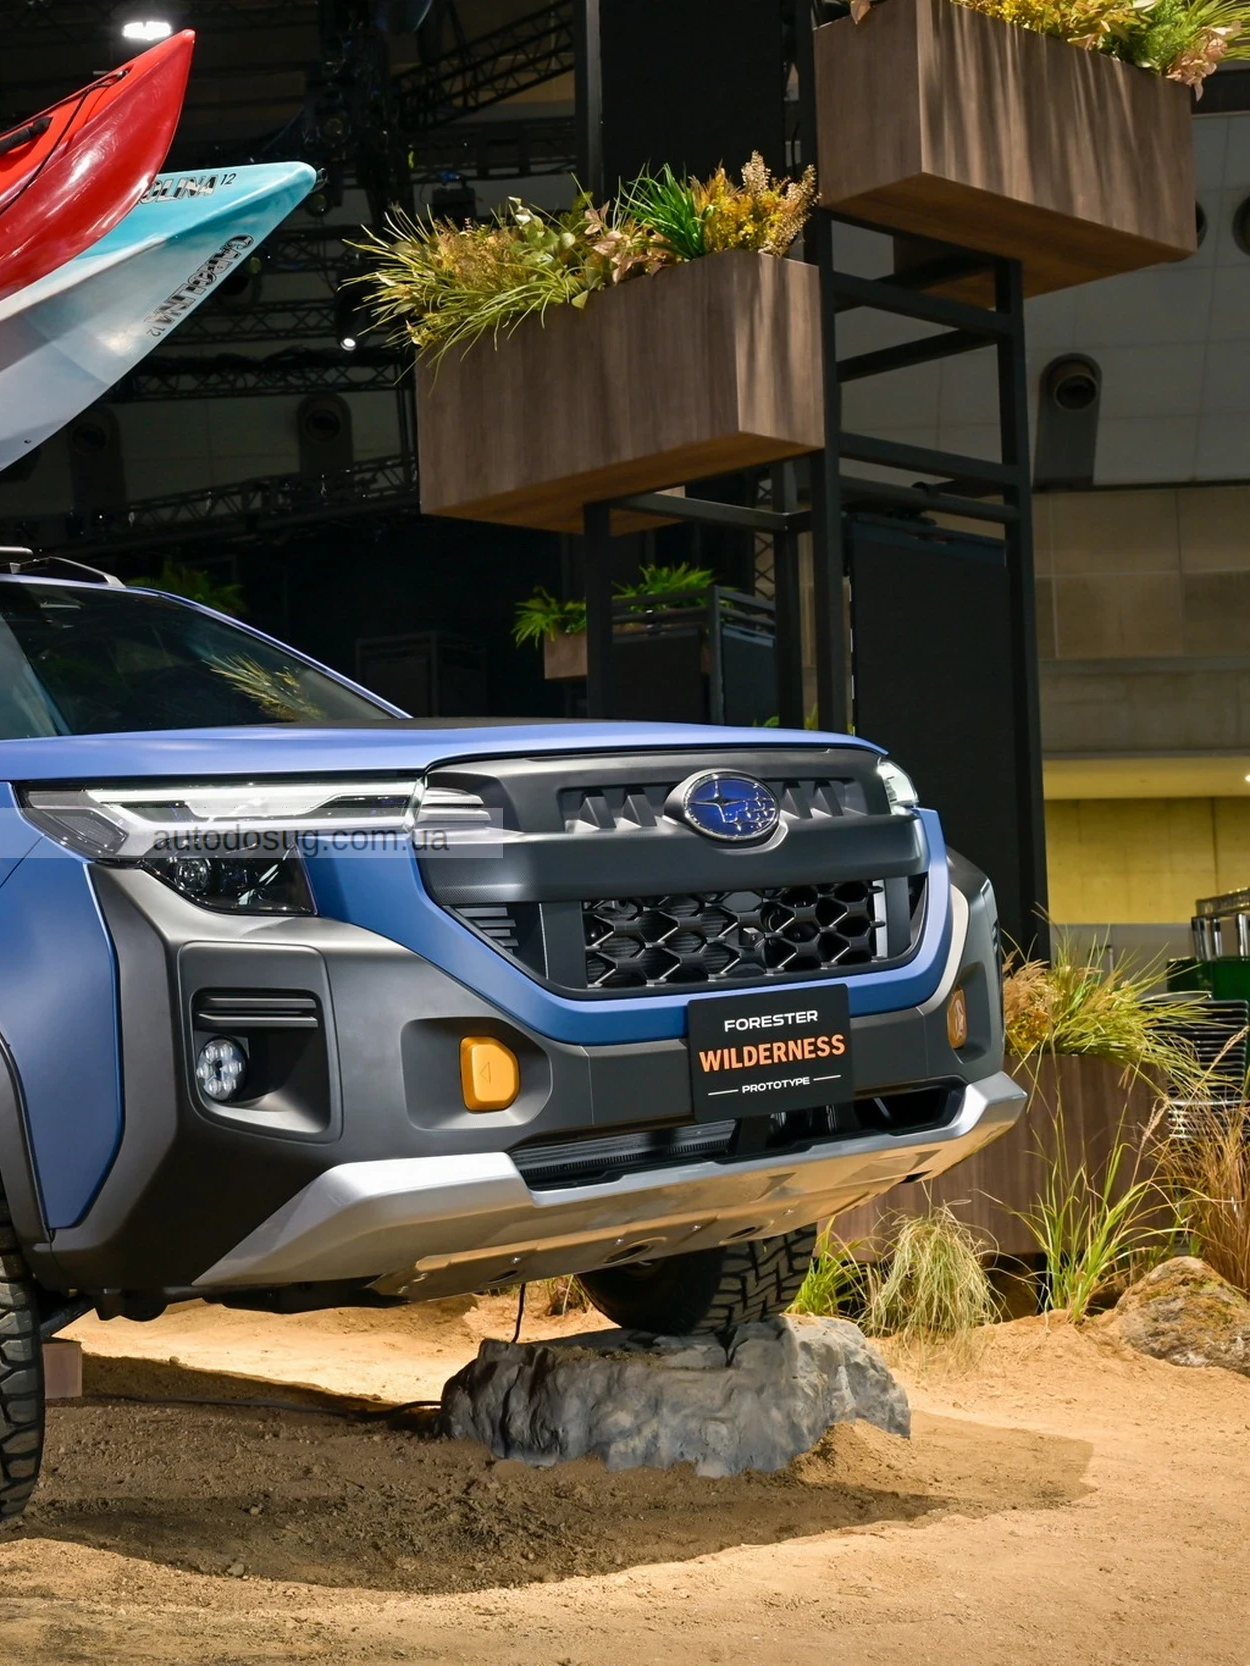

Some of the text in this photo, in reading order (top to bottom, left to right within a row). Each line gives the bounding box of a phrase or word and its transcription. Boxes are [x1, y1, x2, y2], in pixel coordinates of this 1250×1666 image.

[139, 172, 237, 205] OLINA 12
[144, 234, 254, 324] CAROLINA
[724, 1009, 819, 1033] FORESTER
[699, 1033, 846, 1073] WILDERNESS
[741, 1076, 810, 1094] PROTOTYPE
